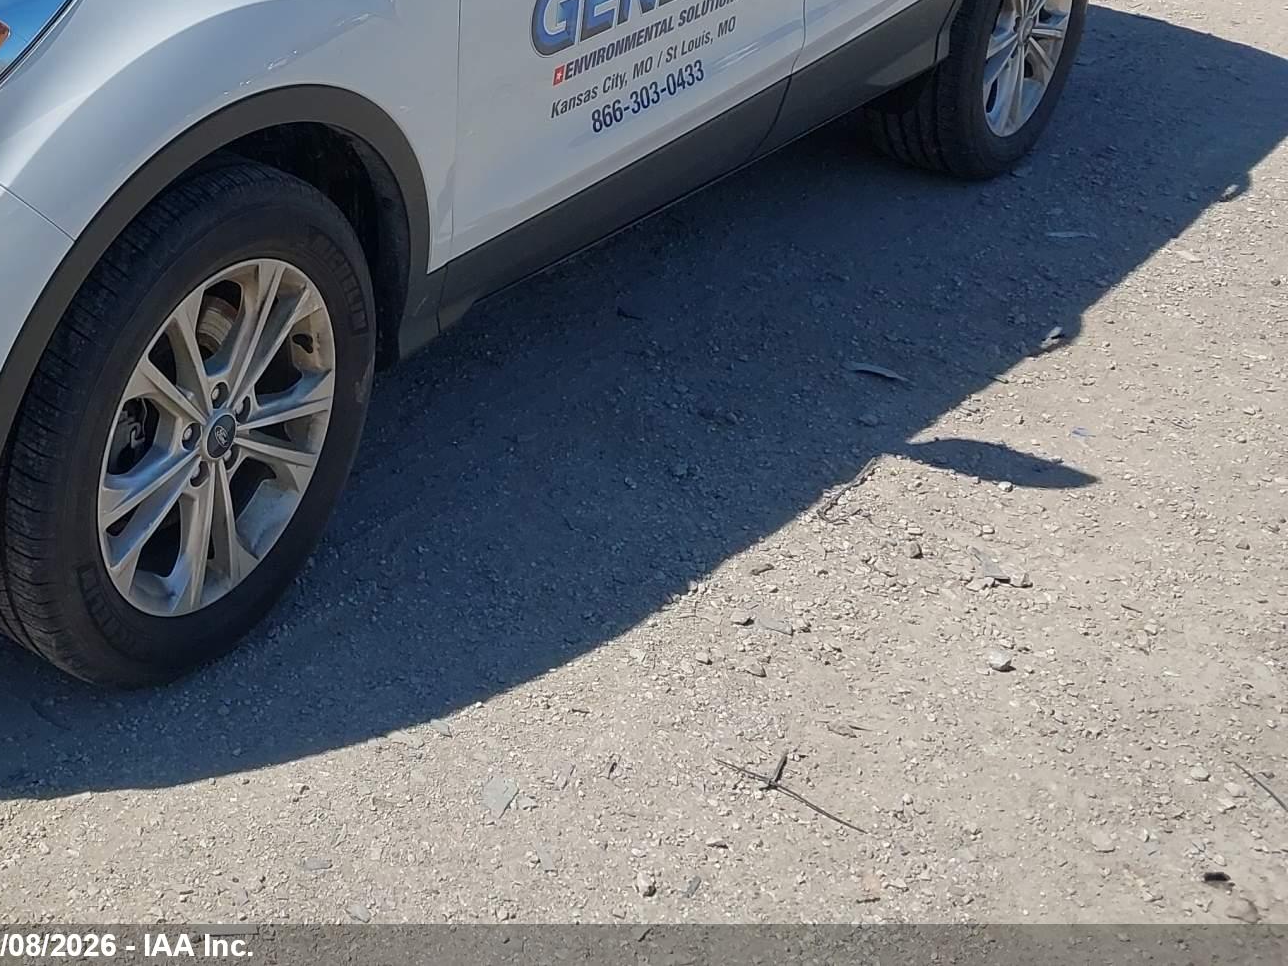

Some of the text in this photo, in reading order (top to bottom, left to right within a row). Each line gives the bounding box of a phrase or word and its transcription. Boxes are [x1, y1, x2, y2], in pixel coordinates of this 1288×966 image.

[551, 86, 598, 118] Kansas
[603, 72, 628, 93] City,
[632, 58, 653, 80] MO
[665, 46, 678, 64] St
[681, 30, 713, 56] Louis,
[717, 16, 737, 39] MO
[564, 16, 674, 81] ENVIRONMENTAL
[591, 59, 705, 133] 866-303-0433
